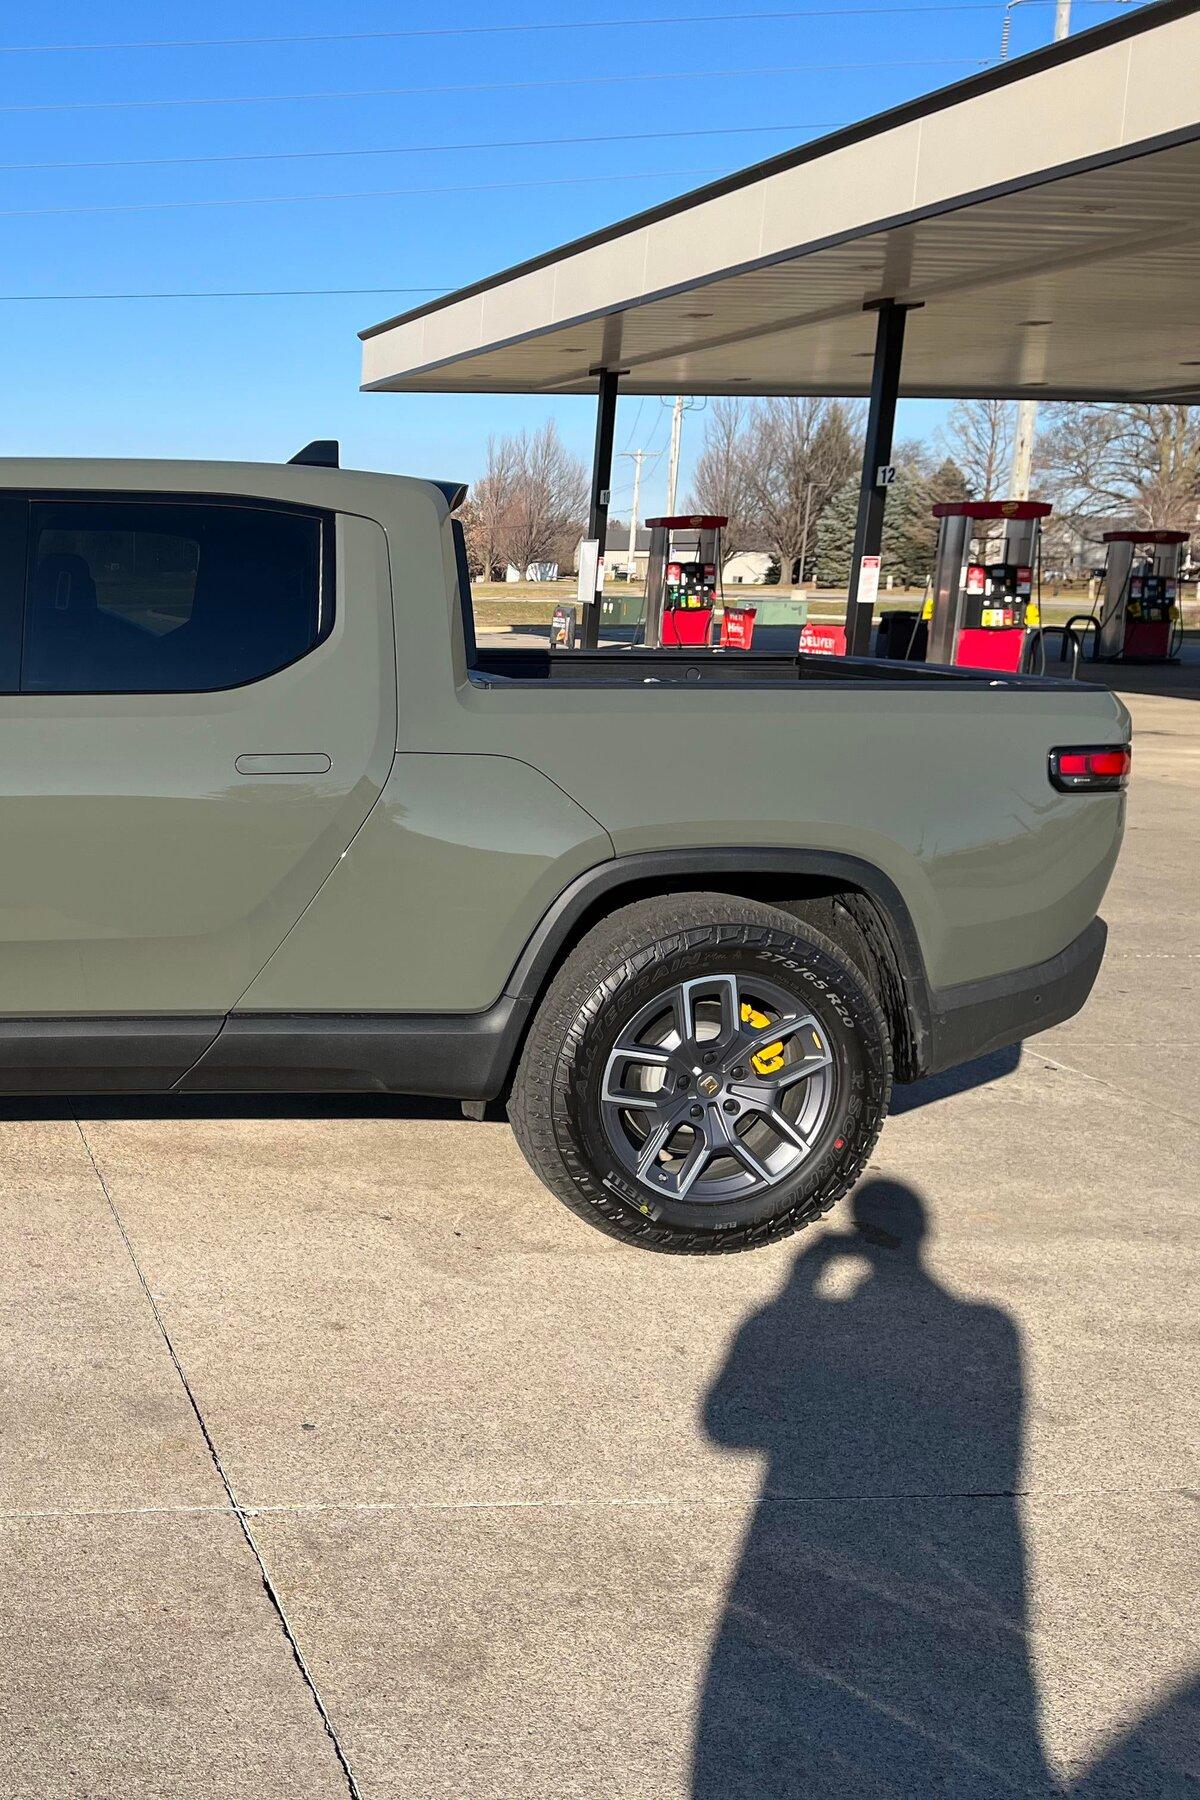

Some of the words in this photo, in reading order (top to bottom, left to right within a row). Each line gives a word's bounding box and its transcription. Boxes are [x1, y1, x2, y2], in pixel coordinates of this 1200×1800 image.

[880, 467, 896, 484] 12
[756, 950, 829, 990] 275/65
[825, 992, 855, 1028] R20
